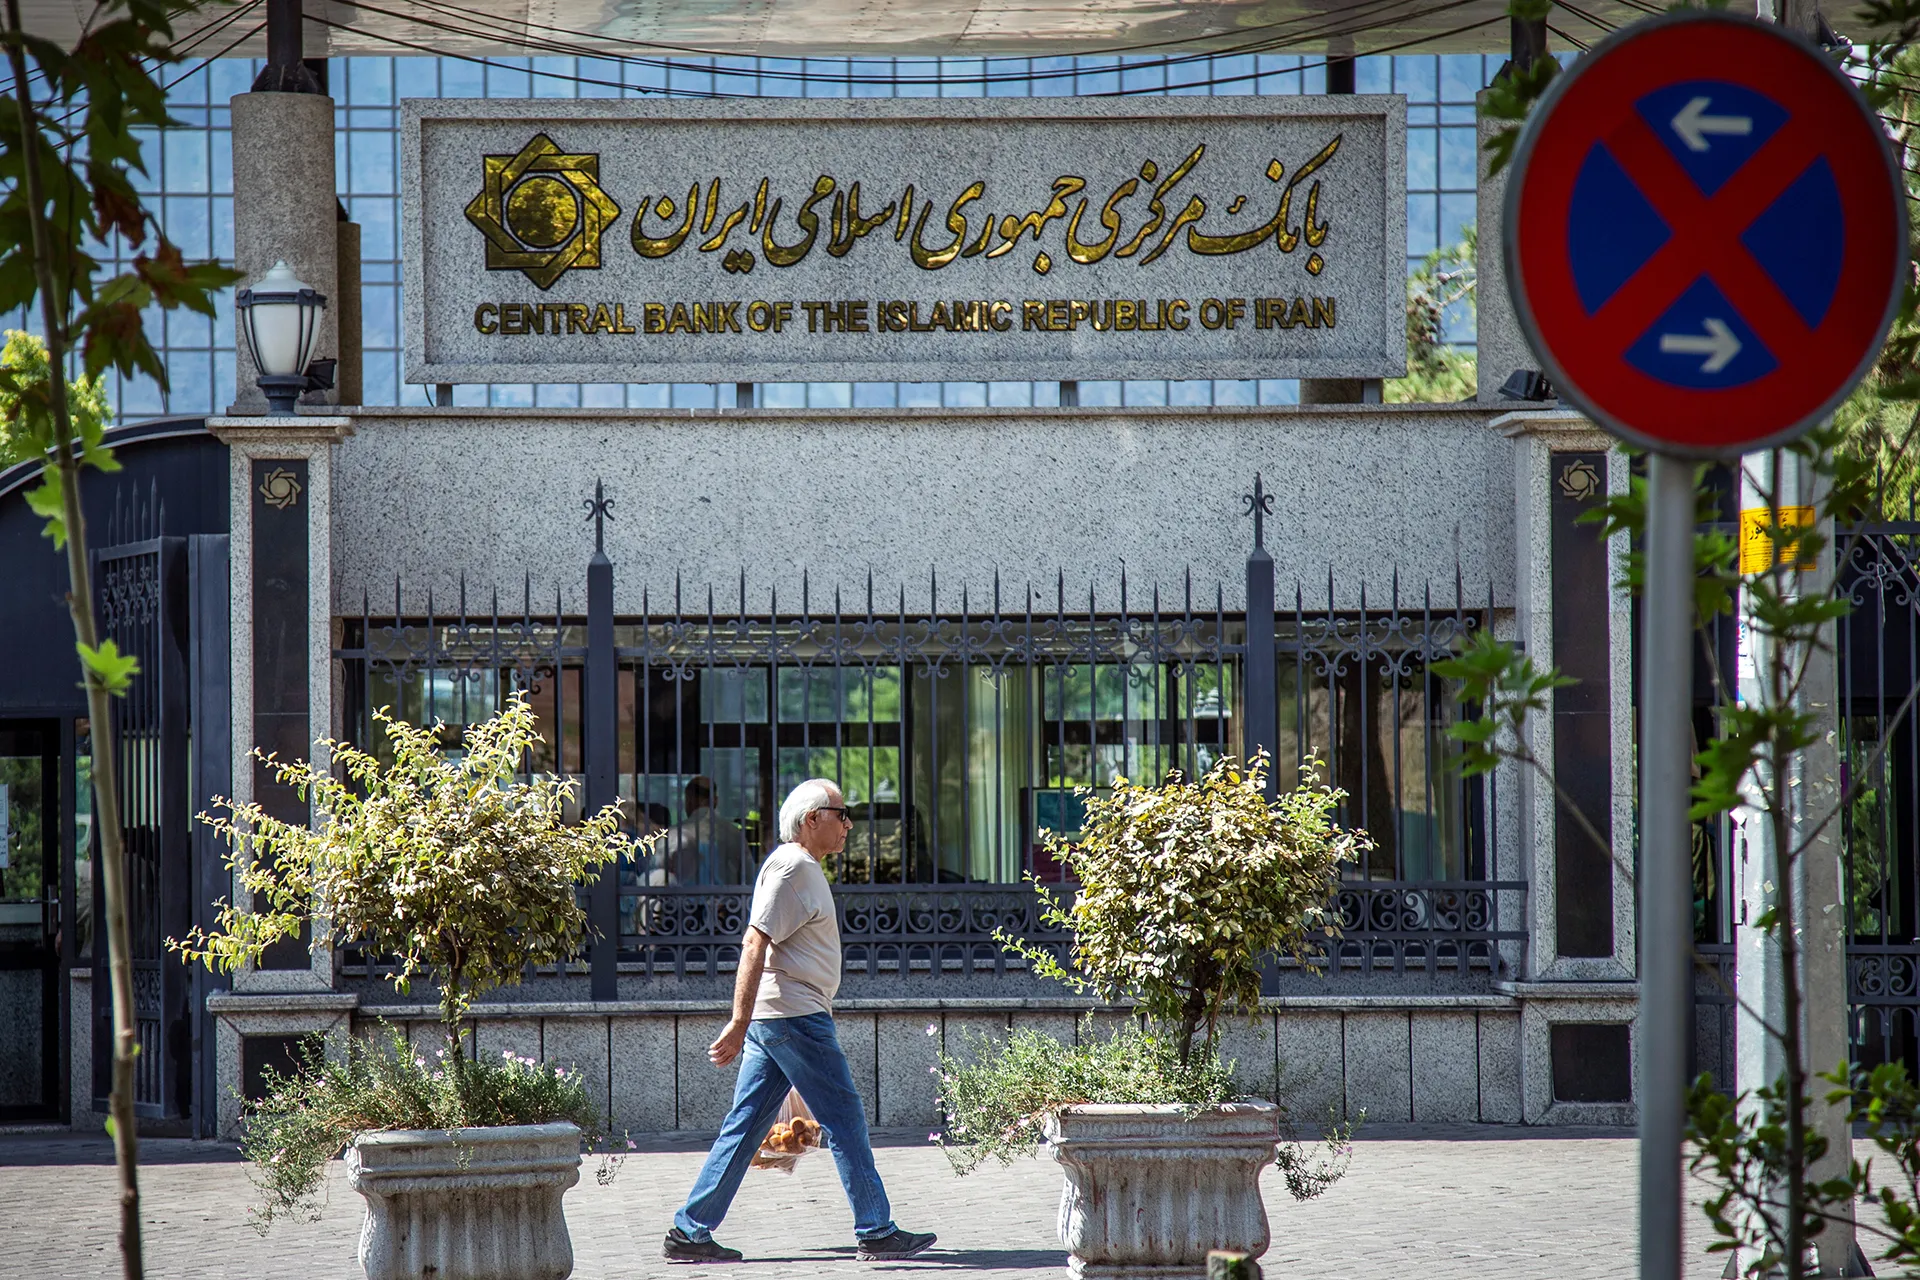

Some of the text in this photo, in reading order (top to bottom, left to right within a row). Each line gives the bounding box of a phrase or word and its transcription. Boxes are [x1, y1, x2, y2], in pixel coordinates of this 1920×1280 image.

[631, 177, 769, 275] ایران
[762, 175, 915, 268] اسلامی
[910, 175, 1087, 276] جمهوری
[1065, 143, 1206, 266] مرکزی
[475, 296, 1336, 335] CENTRAL BANK OF THE ISLAMIC REPUBLIC OF IRAN
